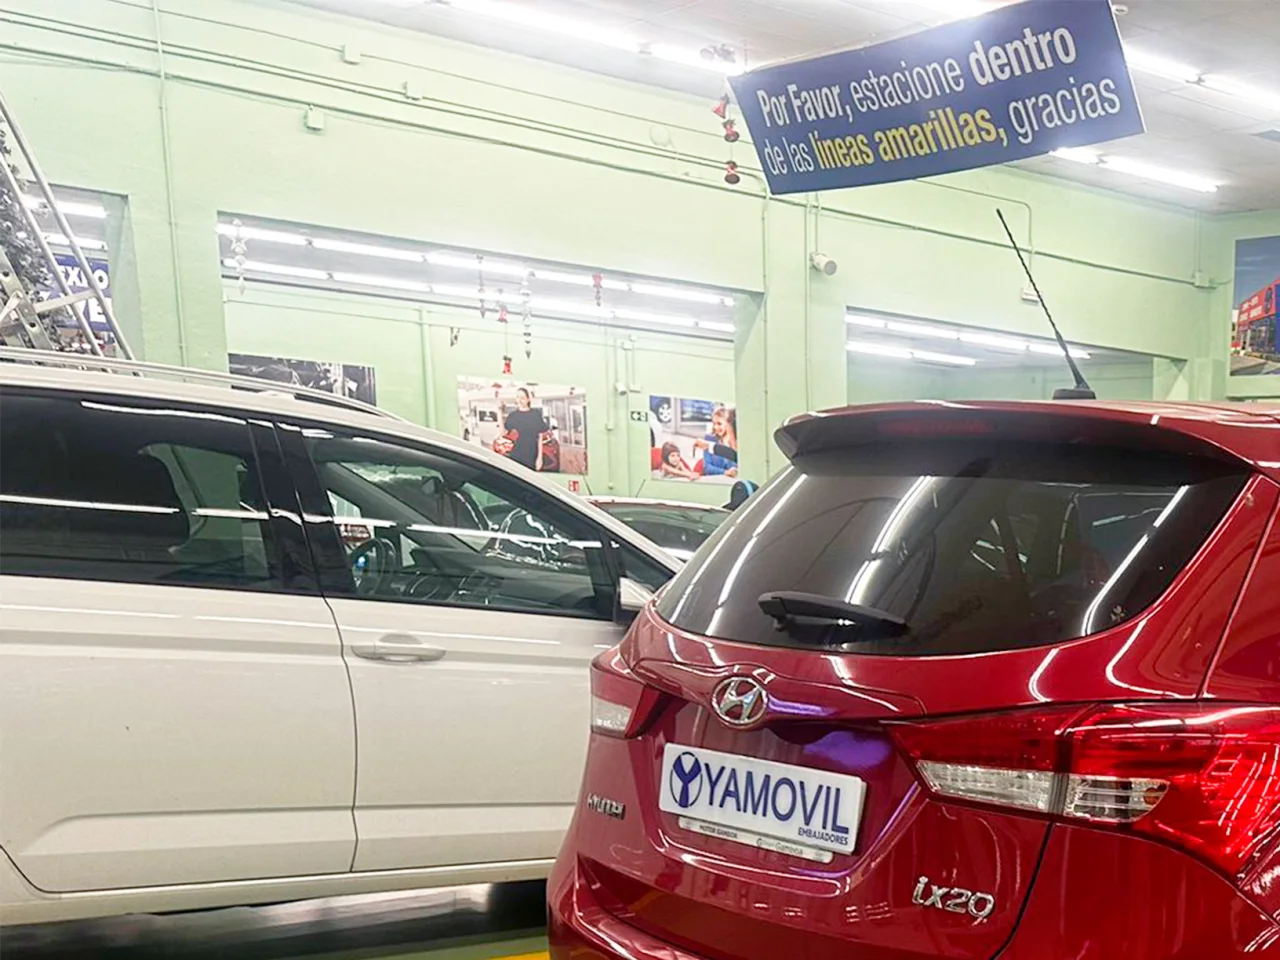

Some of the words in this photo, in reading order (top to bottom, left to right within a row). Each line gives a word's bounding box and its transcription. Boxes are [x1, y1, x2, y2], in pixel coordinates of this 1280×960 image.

[757, 90, 790, 128] Por
[787, 84, 853, 123] Favor,
[850, 60, 965, 113] estacione
[969, 27, 1077, 87] dentro
[764, 139, 788, 176] de
[782, 137, 815, 173] las
[808, 130, 875, 170] líneas
[874, 106, 1008, 162] amarillas,
[1008, 76, 1121, 145] gracias
[704, 762, 849, 834] YAMOVIL
[798, 827, 849, 846] EMBAJADORES
